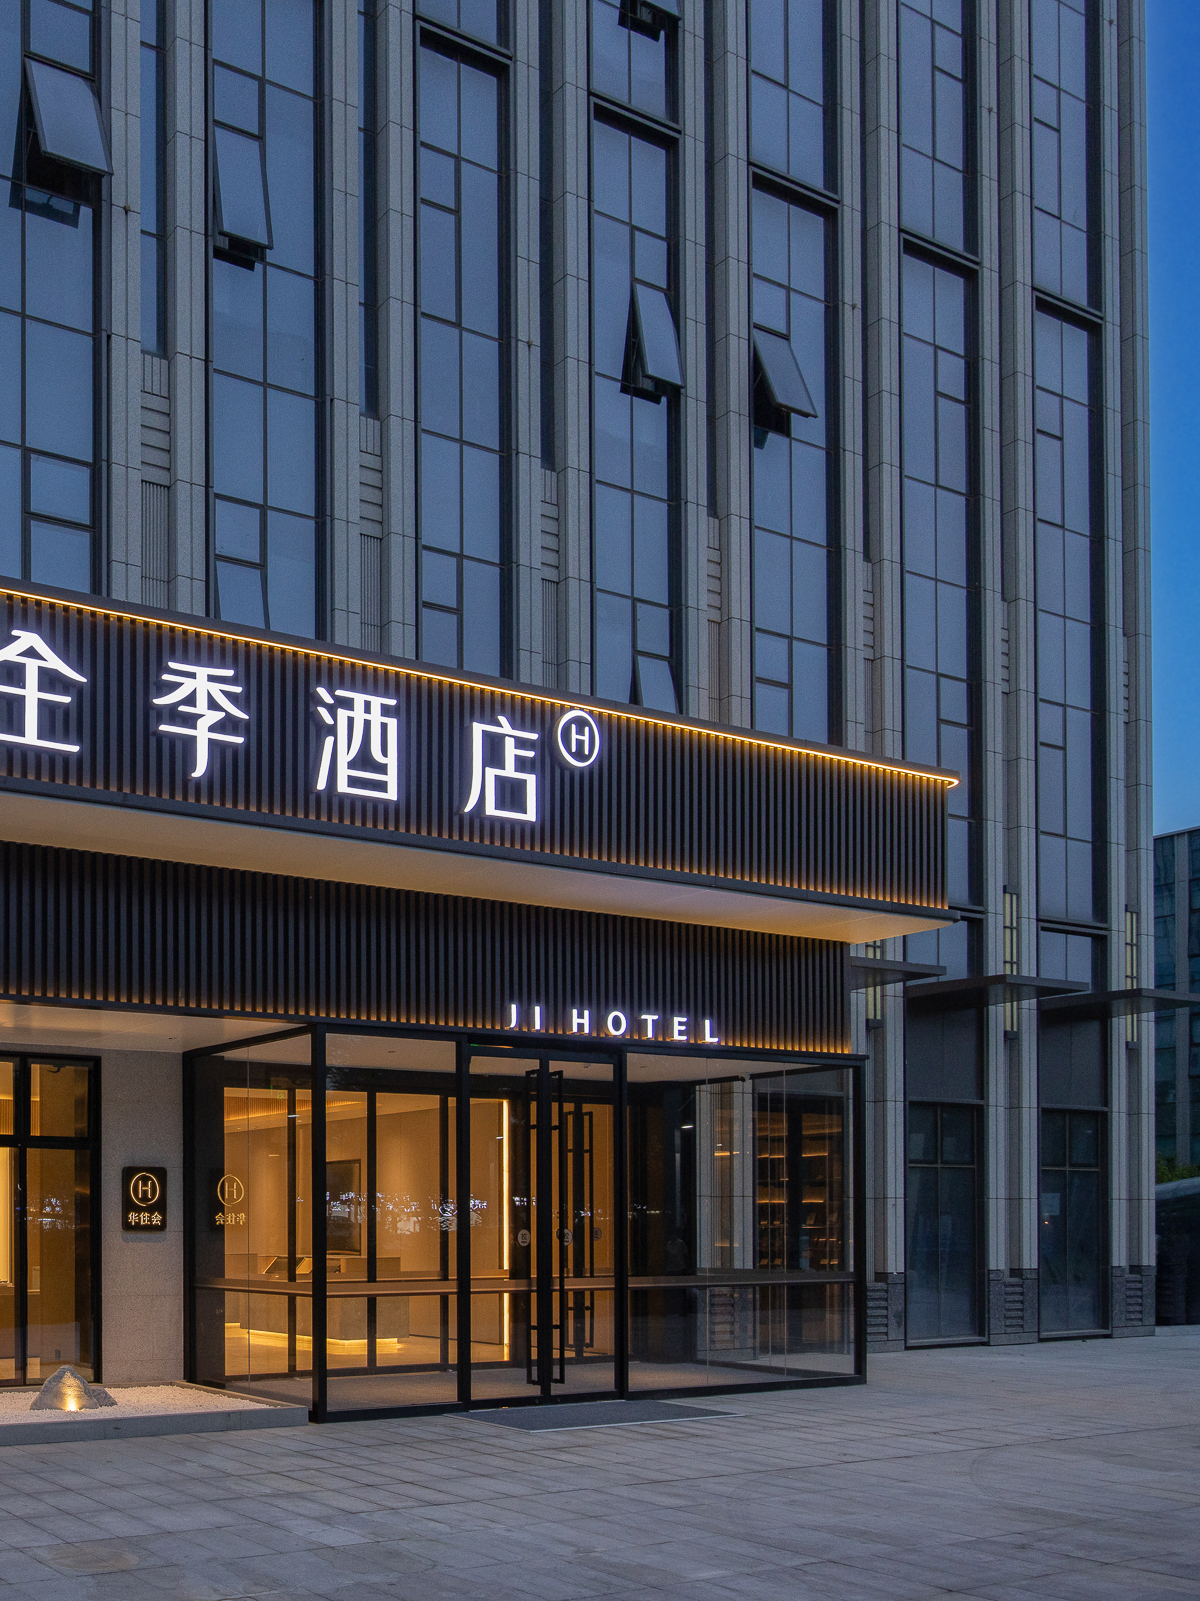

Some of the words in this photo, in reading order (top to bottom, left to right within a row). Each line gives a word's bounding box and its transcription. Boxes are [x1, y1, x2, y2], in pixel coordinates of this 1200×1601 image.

[509, 1003, 541, 1030] JI
[572, 1008, 719, 1043] HOTEL
[128, 1211, 162, 1226] 华住会
